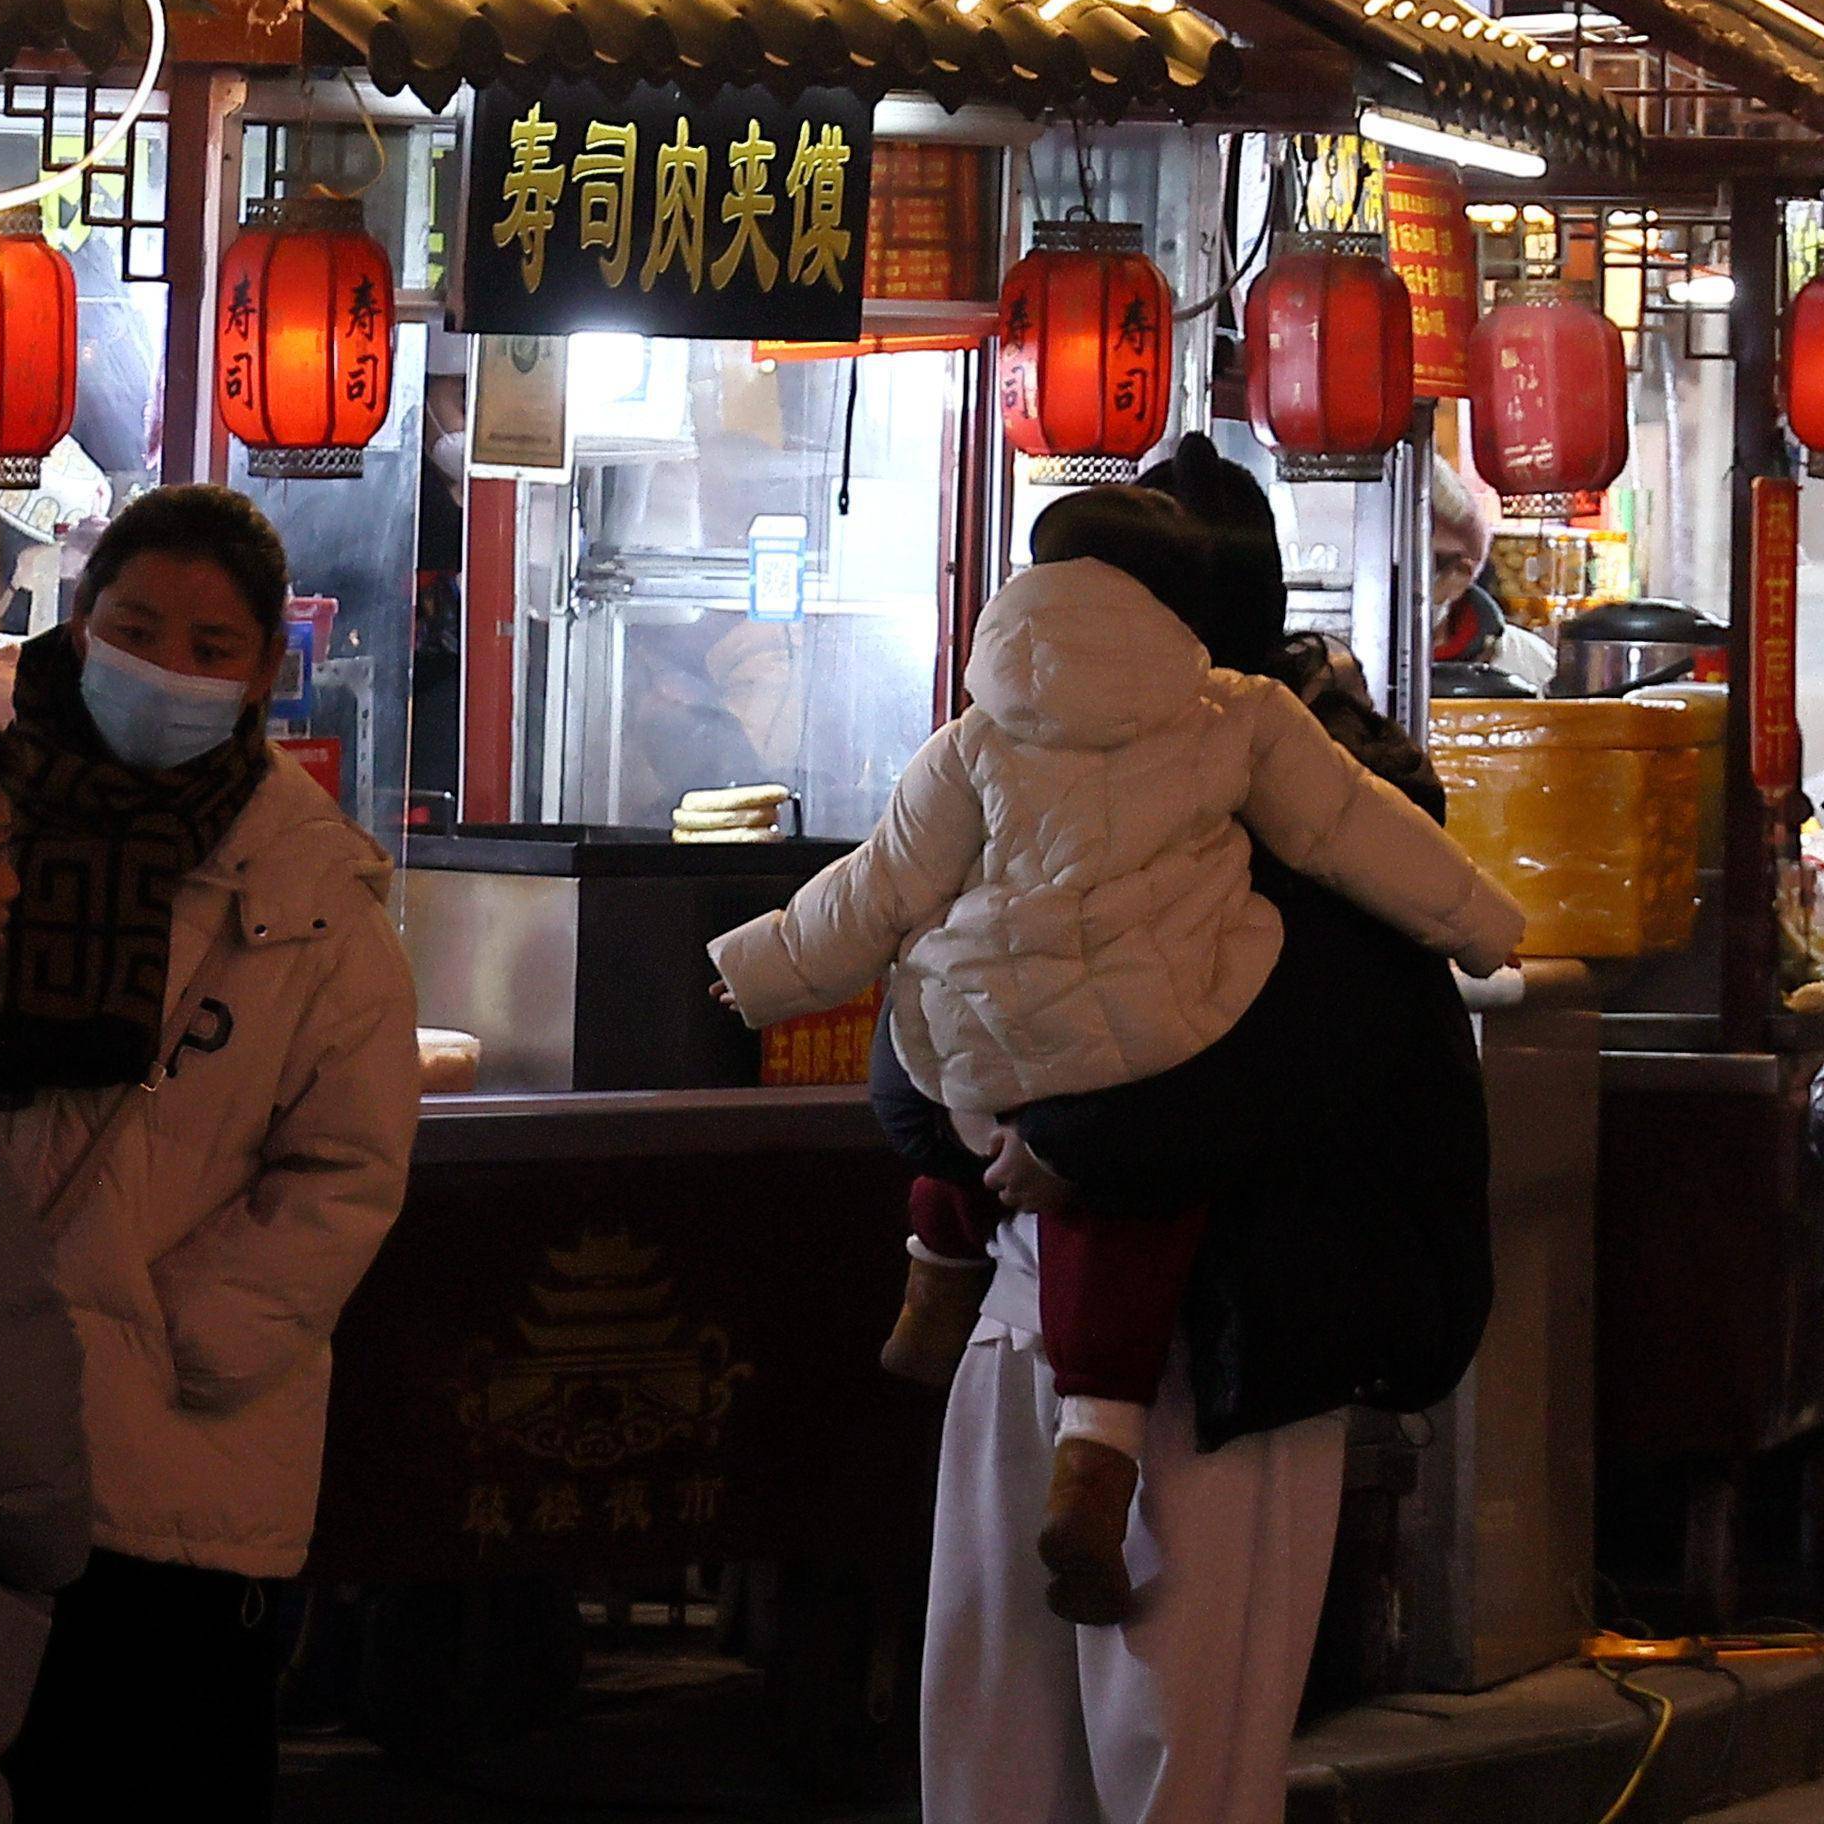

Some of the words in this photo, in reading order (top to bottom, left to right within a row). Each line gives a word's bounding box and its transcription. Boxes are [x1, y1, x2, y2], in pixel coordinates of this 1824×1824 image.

[493, 101, 852, 293] 寿司肉夹馍
[224, 272, 257, 410] 寿司
[345, 274, 383, 413] 寿司
[1114, 294, 1157, 421] 寿司
